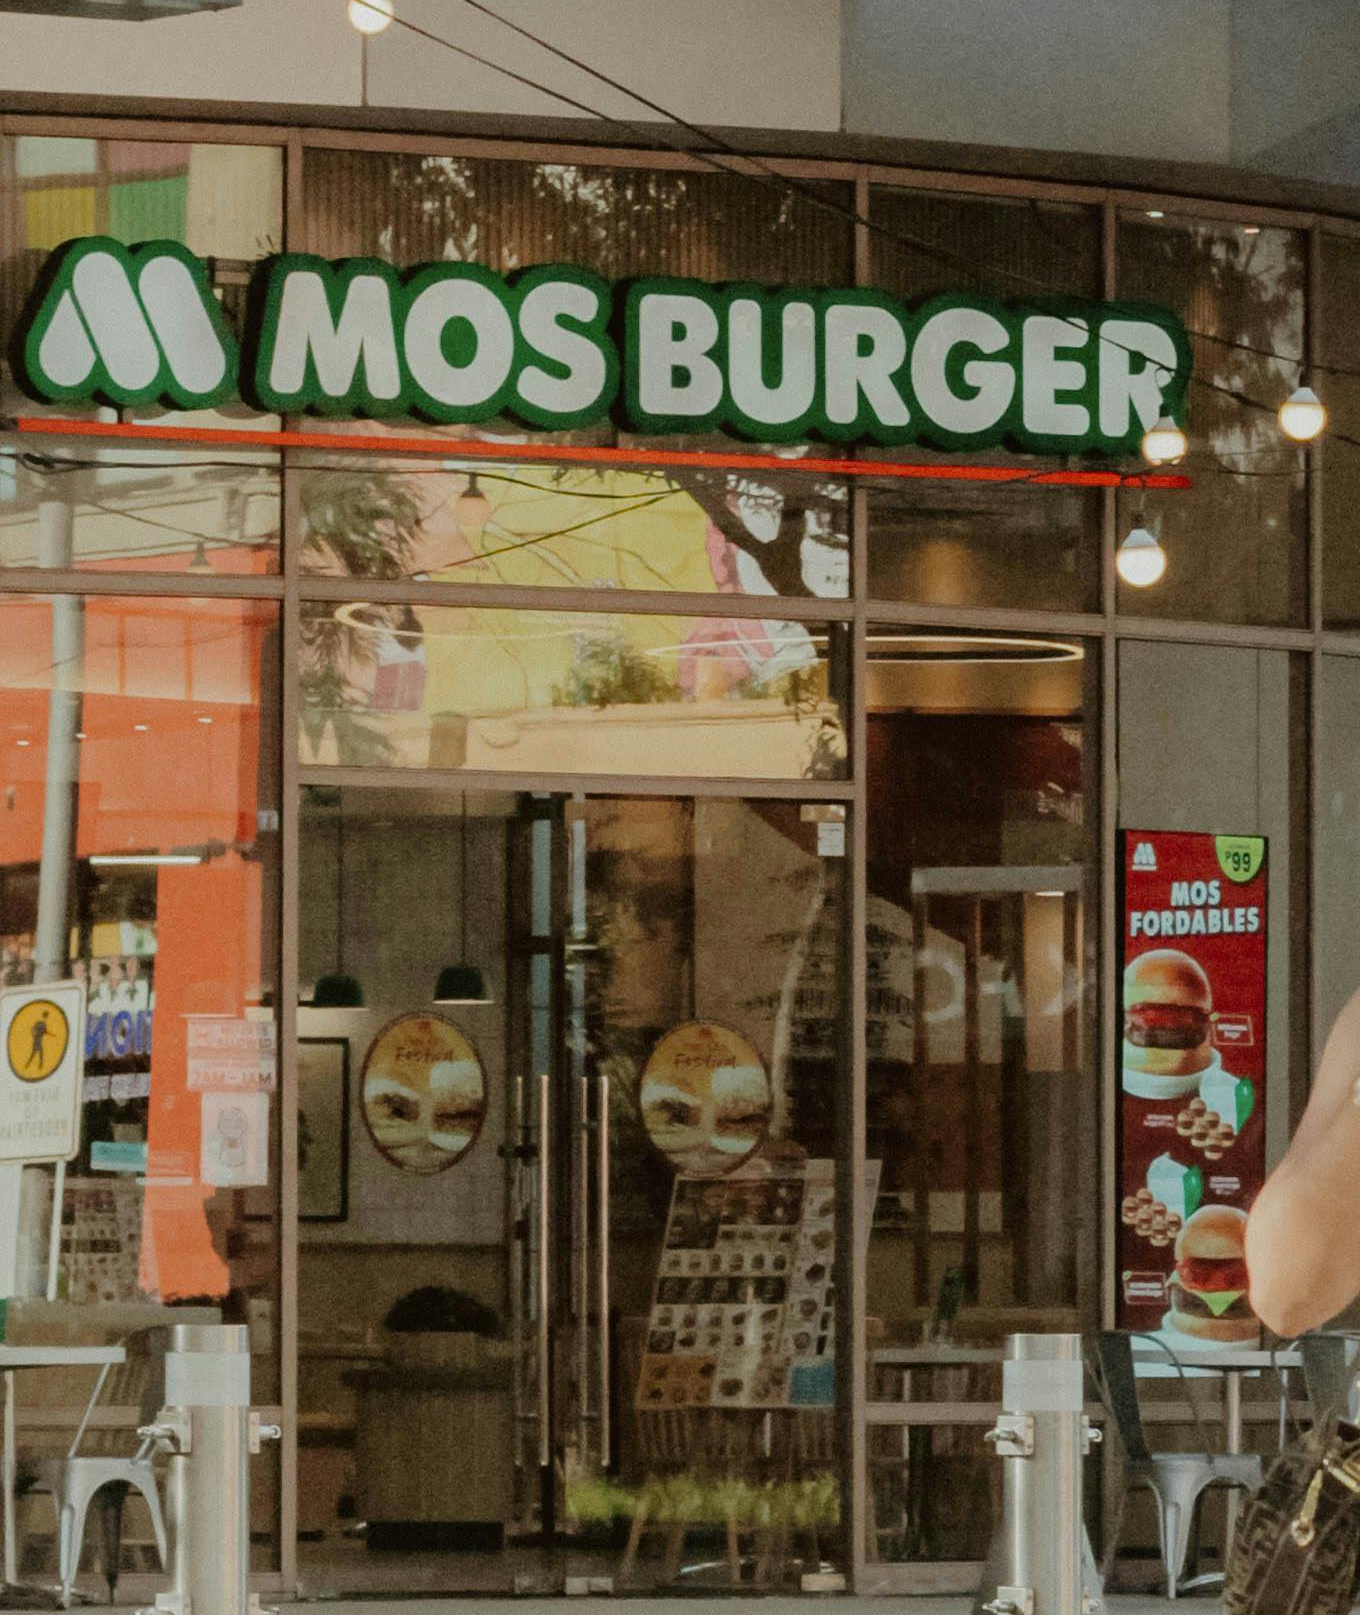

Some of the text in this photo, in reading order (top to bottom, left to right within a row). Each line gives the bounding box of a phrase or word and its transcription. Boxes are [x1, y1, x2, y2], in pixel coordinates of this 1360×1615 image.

[270, 270, 1179, 438] MOS BURGER
[1170, 879, 1221, 907] MOS
[1130, 907, 1260, 937] FORDABLES
